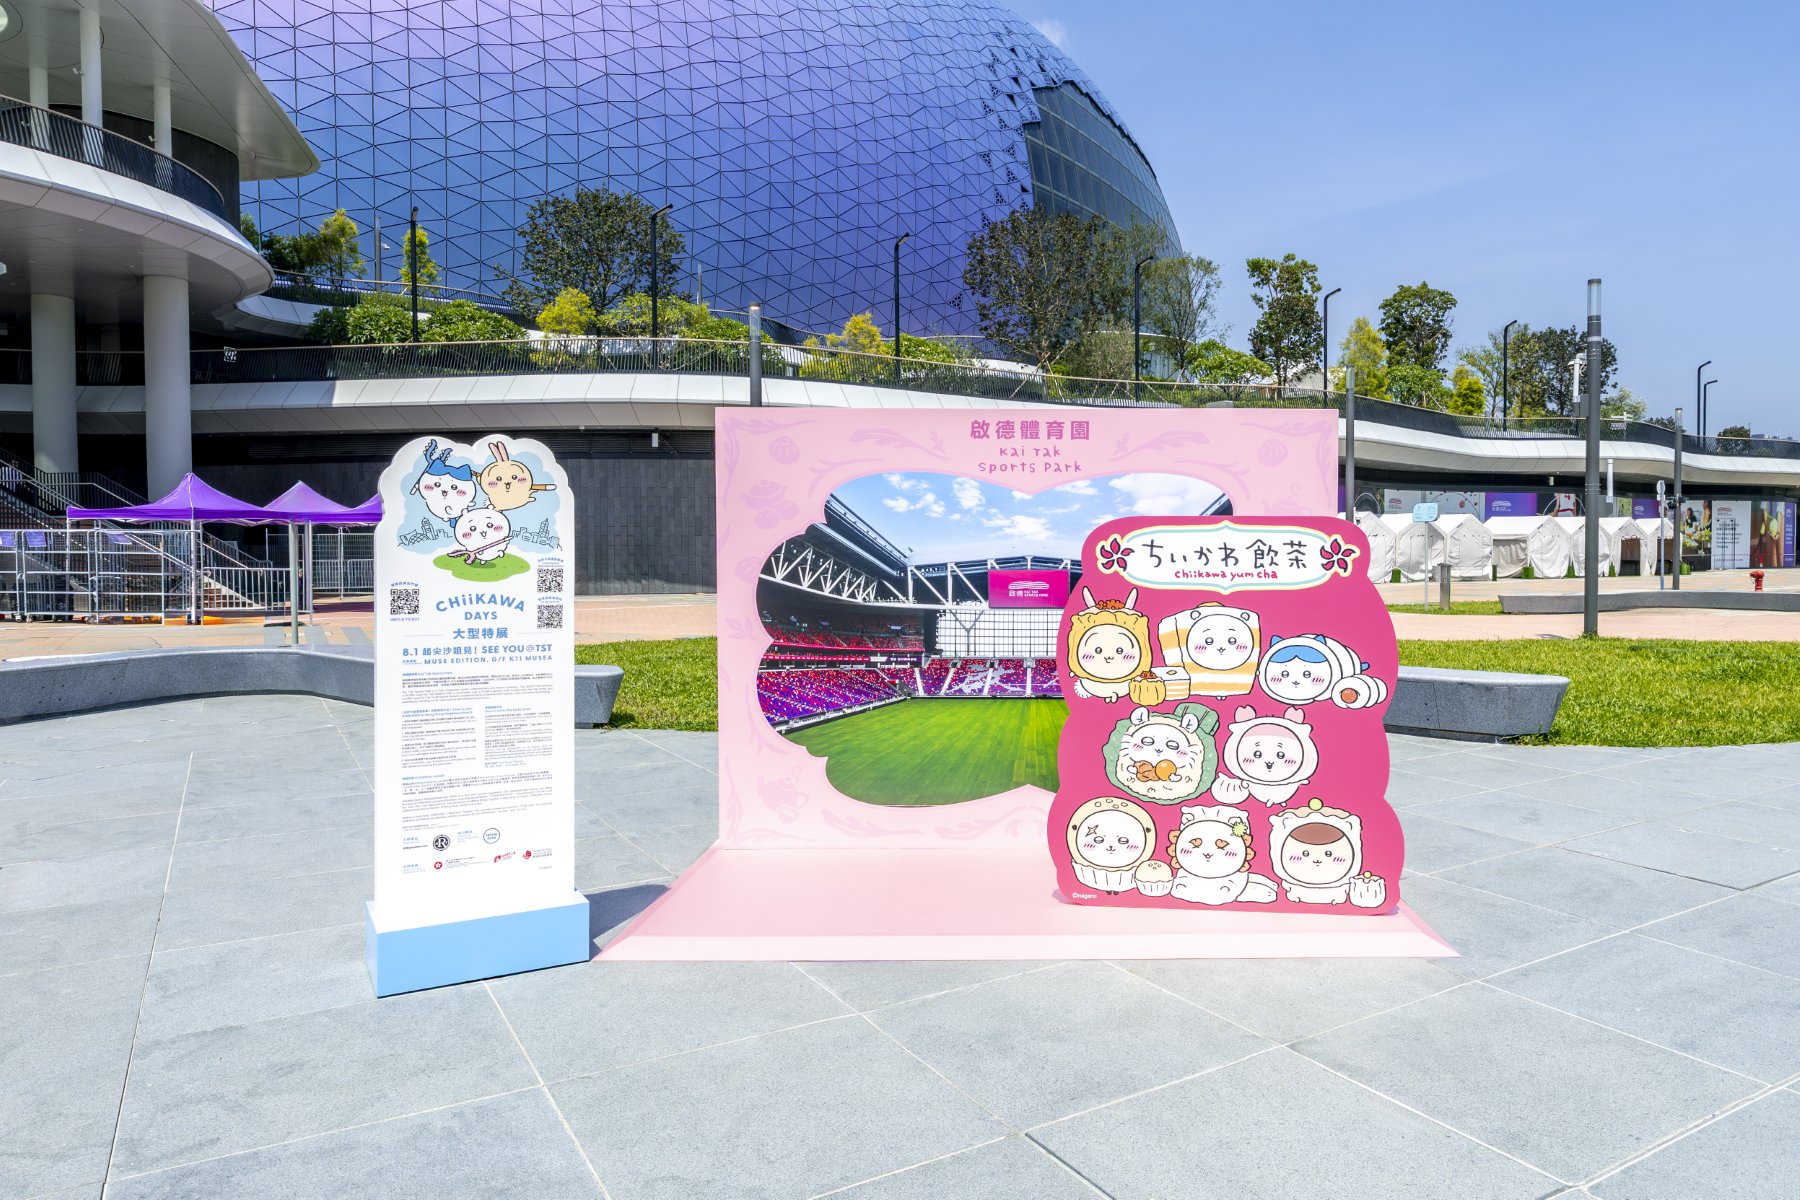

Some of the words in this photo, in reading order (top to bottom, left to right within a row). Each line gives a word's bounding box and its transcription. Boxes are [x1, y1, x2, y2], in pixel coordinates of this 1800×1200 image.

[970, 419, 1090, 440] 啟德體育園
[978, 461, 1036, 474] Sports
[1044, 460, 1082, 473] Park
[1142, 538, 1307, 569] ちいかわ飲茶
[1230, 571, 1254, 582] yum
[1256, 569, 1278, 579] cha
[464, 611, 498, 620] DAYS
[452, 627, 508, 640] 大型特展
[402, 648, 418, 656] 8.1
[481, 645, 500, 654] SEE
